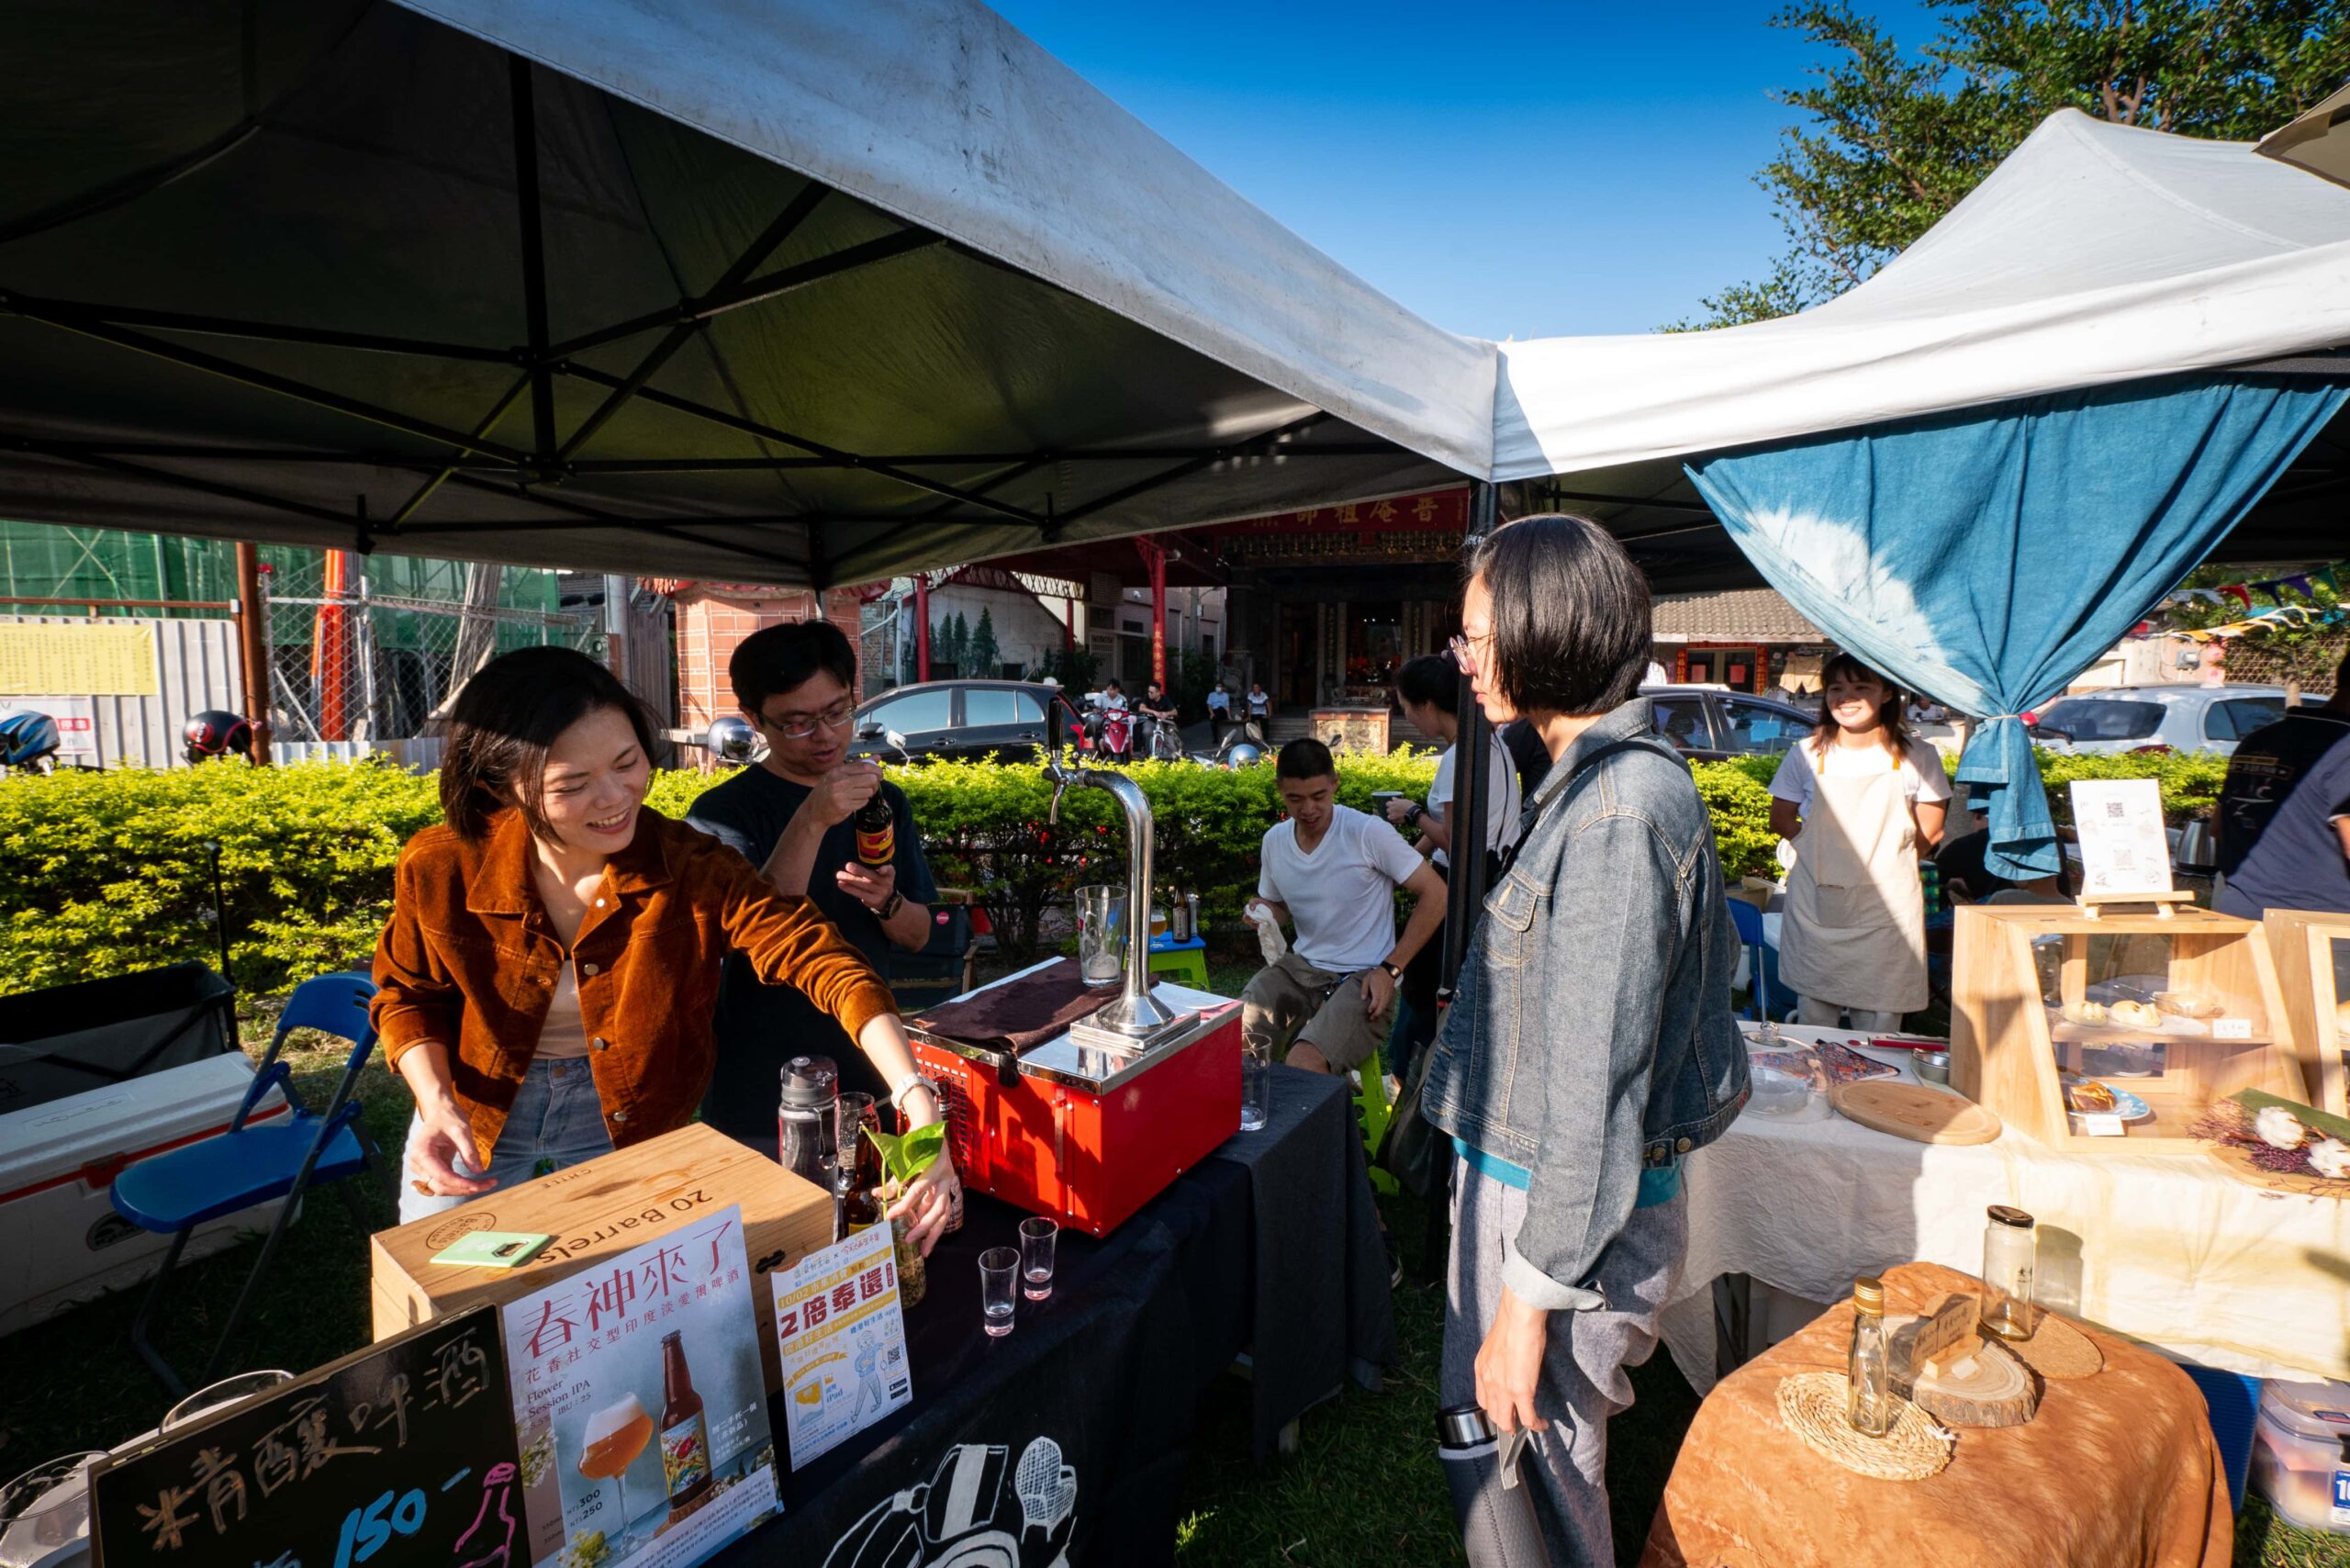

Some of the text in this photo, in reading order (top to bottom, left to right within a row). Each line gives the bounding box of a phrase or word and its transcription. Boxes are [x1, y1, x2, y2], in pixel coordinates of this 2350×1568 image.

[542, 1168, 592, 1190] CHILE
[535, 1189, 713, 1264] 20 Barrels
[527, 1380, 564, 1405] Flower
[528, 1379, 591, 1418] Session IPA
[825, 1387, 844, 1404] iPad
